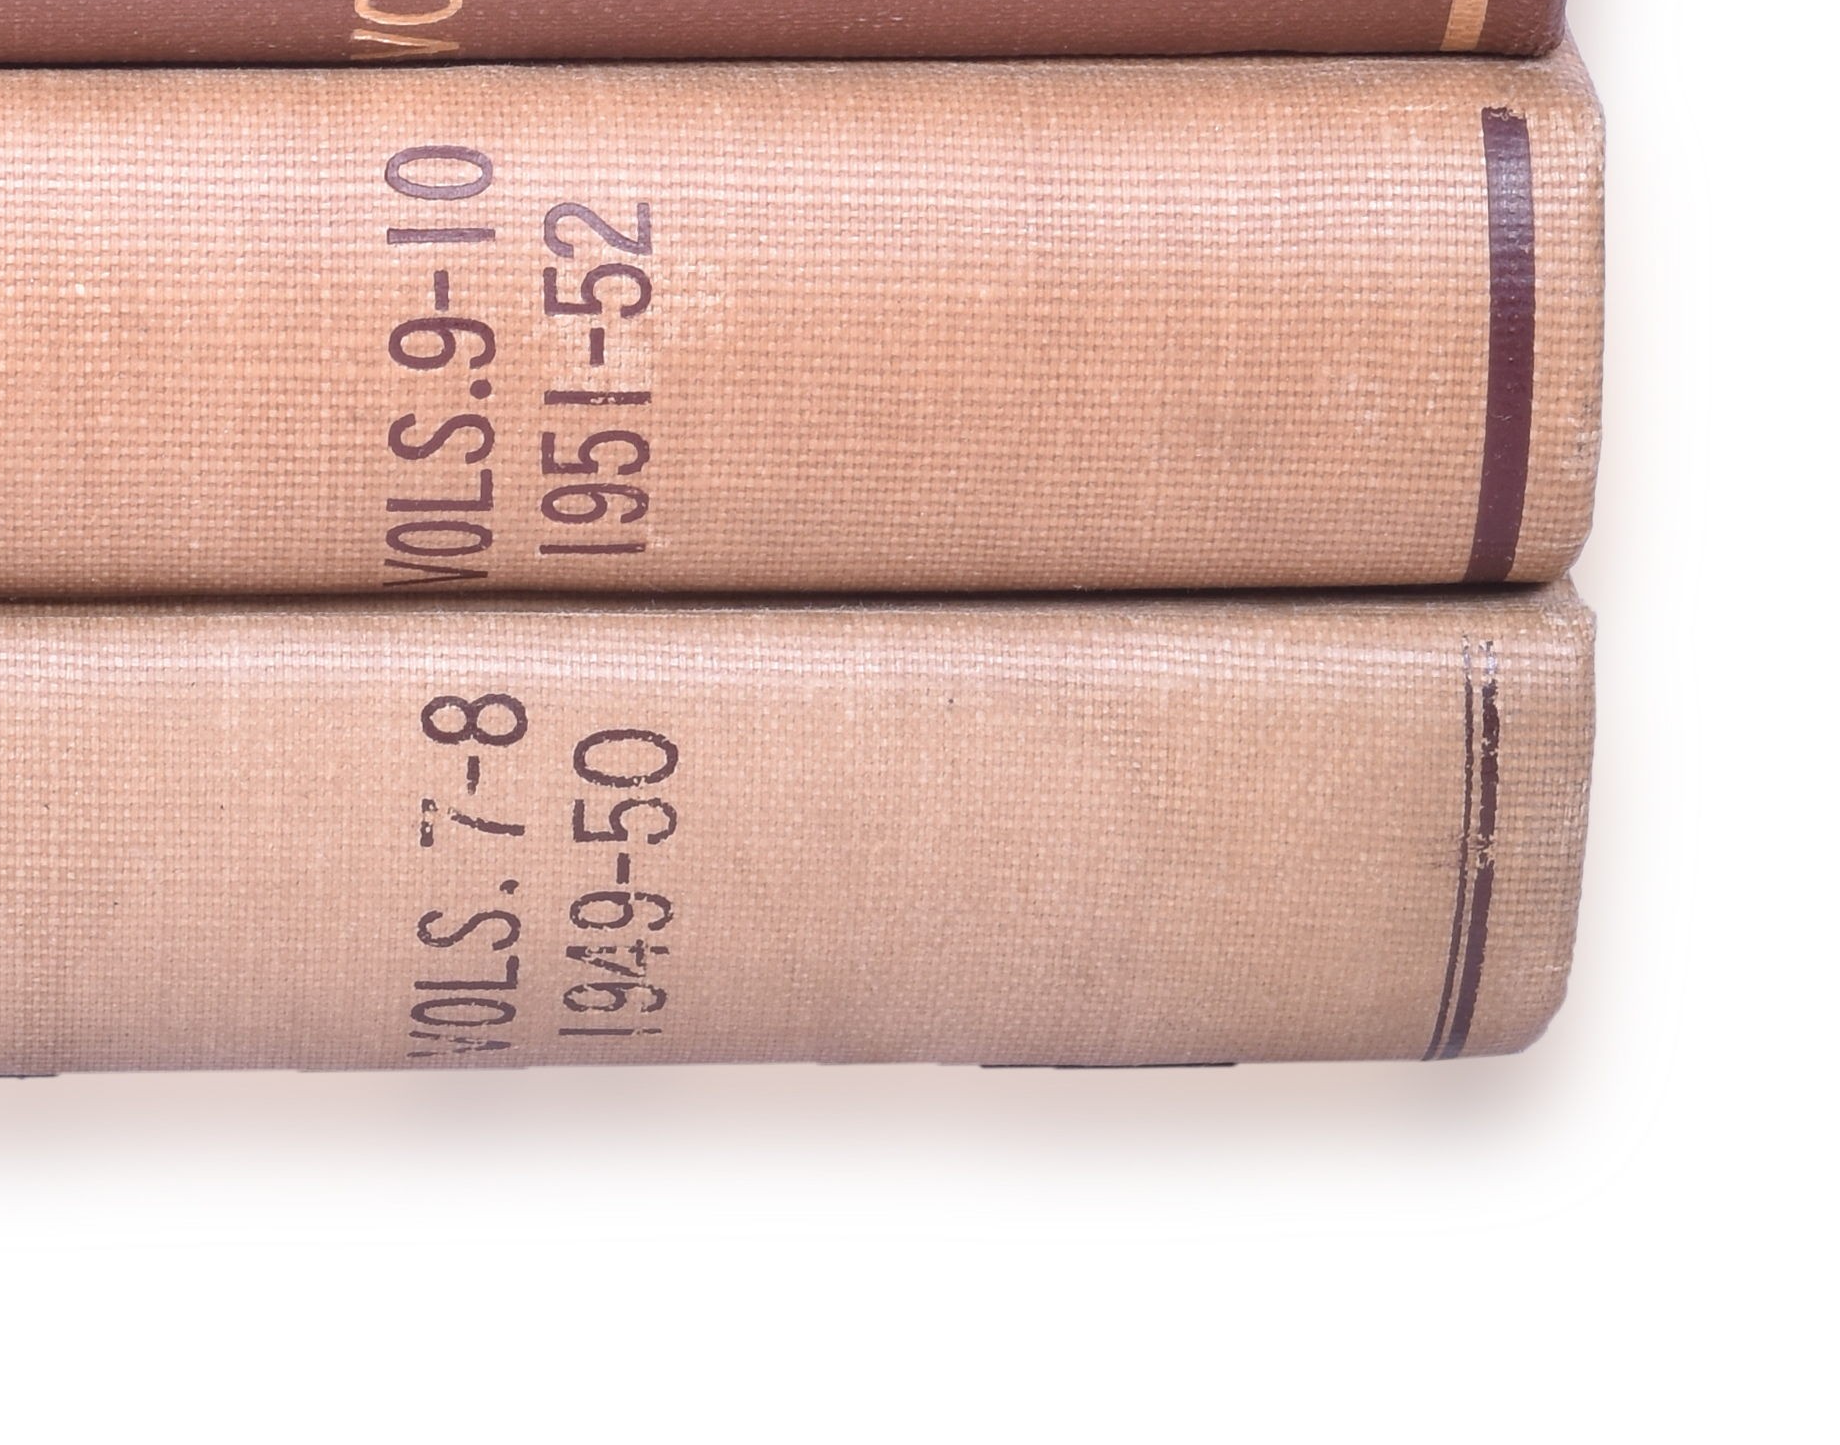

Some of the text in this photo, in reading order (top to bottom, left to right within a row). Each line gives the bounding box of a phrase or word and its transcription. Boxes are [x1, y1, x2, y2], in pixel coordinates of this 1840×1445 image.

[540, 202, 652, 554] 1951-52
[407, 693, 528, 1057] VOLS. 7-8
[560, 728, 679, 1036] 1949-50
